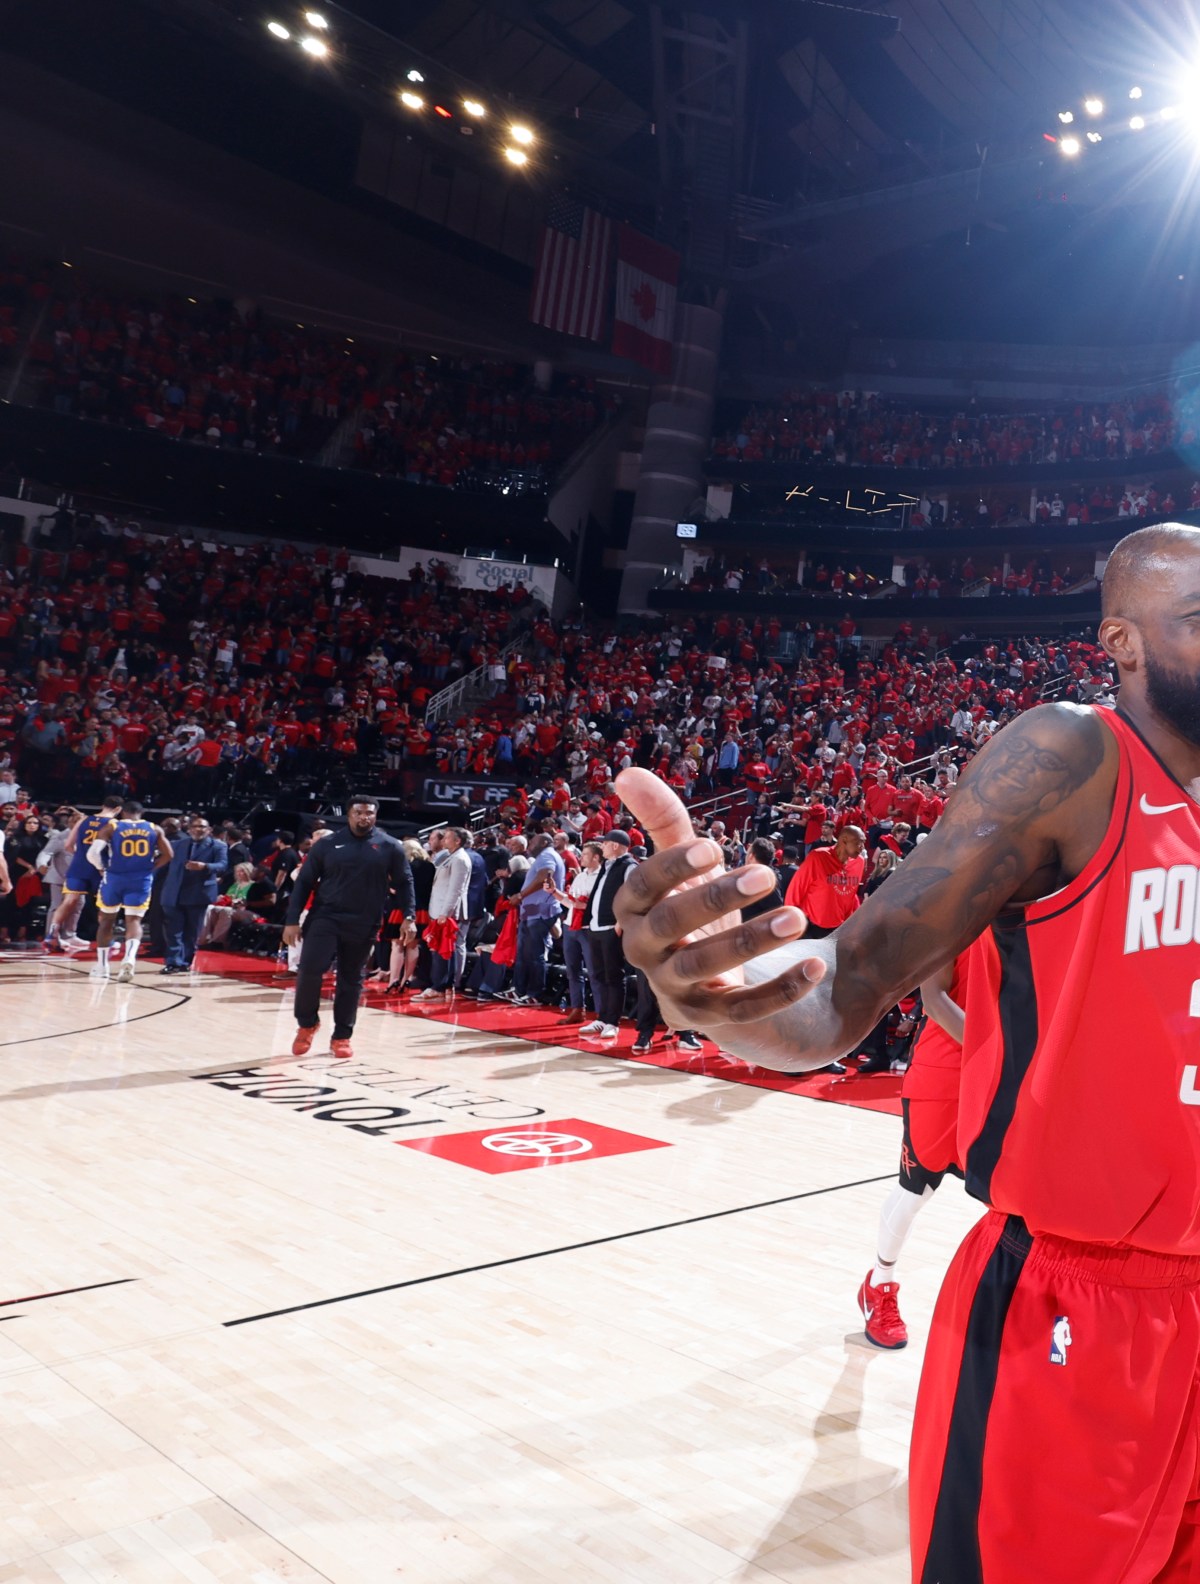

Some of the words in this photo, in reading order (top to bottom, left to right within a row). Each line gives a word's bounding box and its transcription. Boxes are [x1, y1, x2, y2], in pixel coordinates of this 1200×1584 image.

[476, 562, 534, 582] Social
[121, 839, 149, 857] 00
[188, 1066, 447, 1137] TOYOTA
[297, 1059, 546, 1120] CENTER
